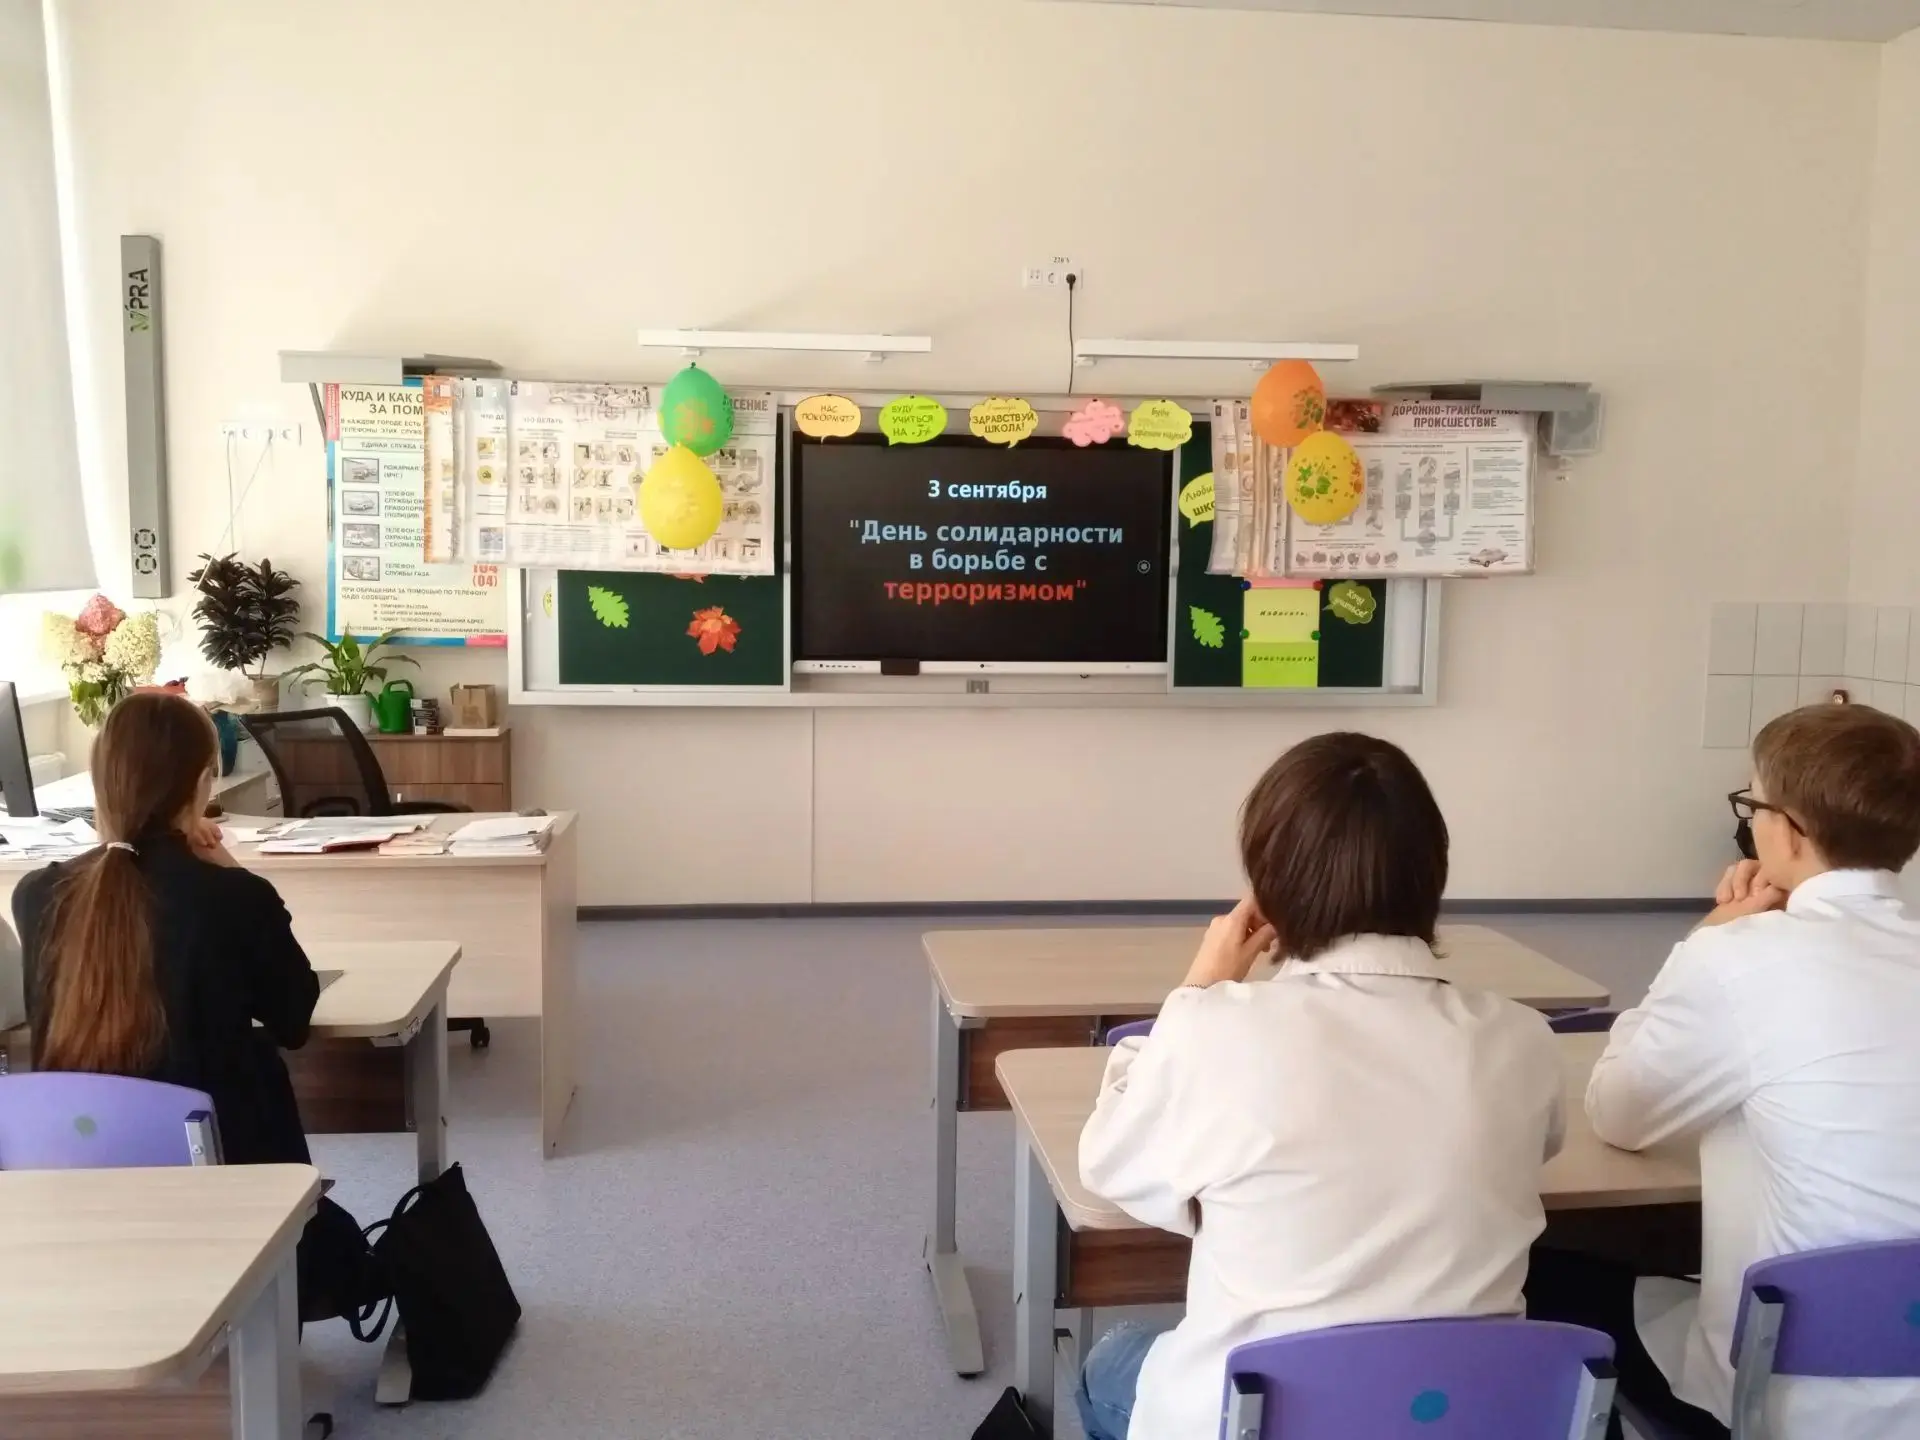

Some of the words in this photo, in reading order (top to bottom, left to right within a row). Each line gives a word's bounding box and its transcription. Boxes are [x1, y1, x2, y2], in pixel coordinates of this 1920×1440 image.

[341, 390, 373, 403] КУДА
[377, 392, 385, 401] И
[389, 392, 413, 403] КАК
[369, 404, 387, 414] ЗА
[393, 405, 423, 415] ПОМ
[892, 405, 914, 413] БУДУ
[801, 413, 855, 423] ПОКОРМЯТ?
[892, 414, 934, 424] УЧИТЬСЯ
[972, 412, 1037, 425] ЗДРАВСТВУЙ,
[1413, 417, 1497, 428] ПРОИСШЕСТВИЕ
[893, 428, 908, 437] НА
[984, 422, 1025, 433] ШКОЛА!
[928, 479, 941, 498] 3
[948, 481, 1047, 502] сентября
[849, 519, 928, 544] "День
[936, 525, 1123, 548] солидарности
[910, 553, 923, 569] в
[932, 549, 1026, 574] борьбе
[1035, 555, 1047, 571] с
[472, 575, 498, 587] (04)
[884, 580, 1087, 606] терроризмом"
